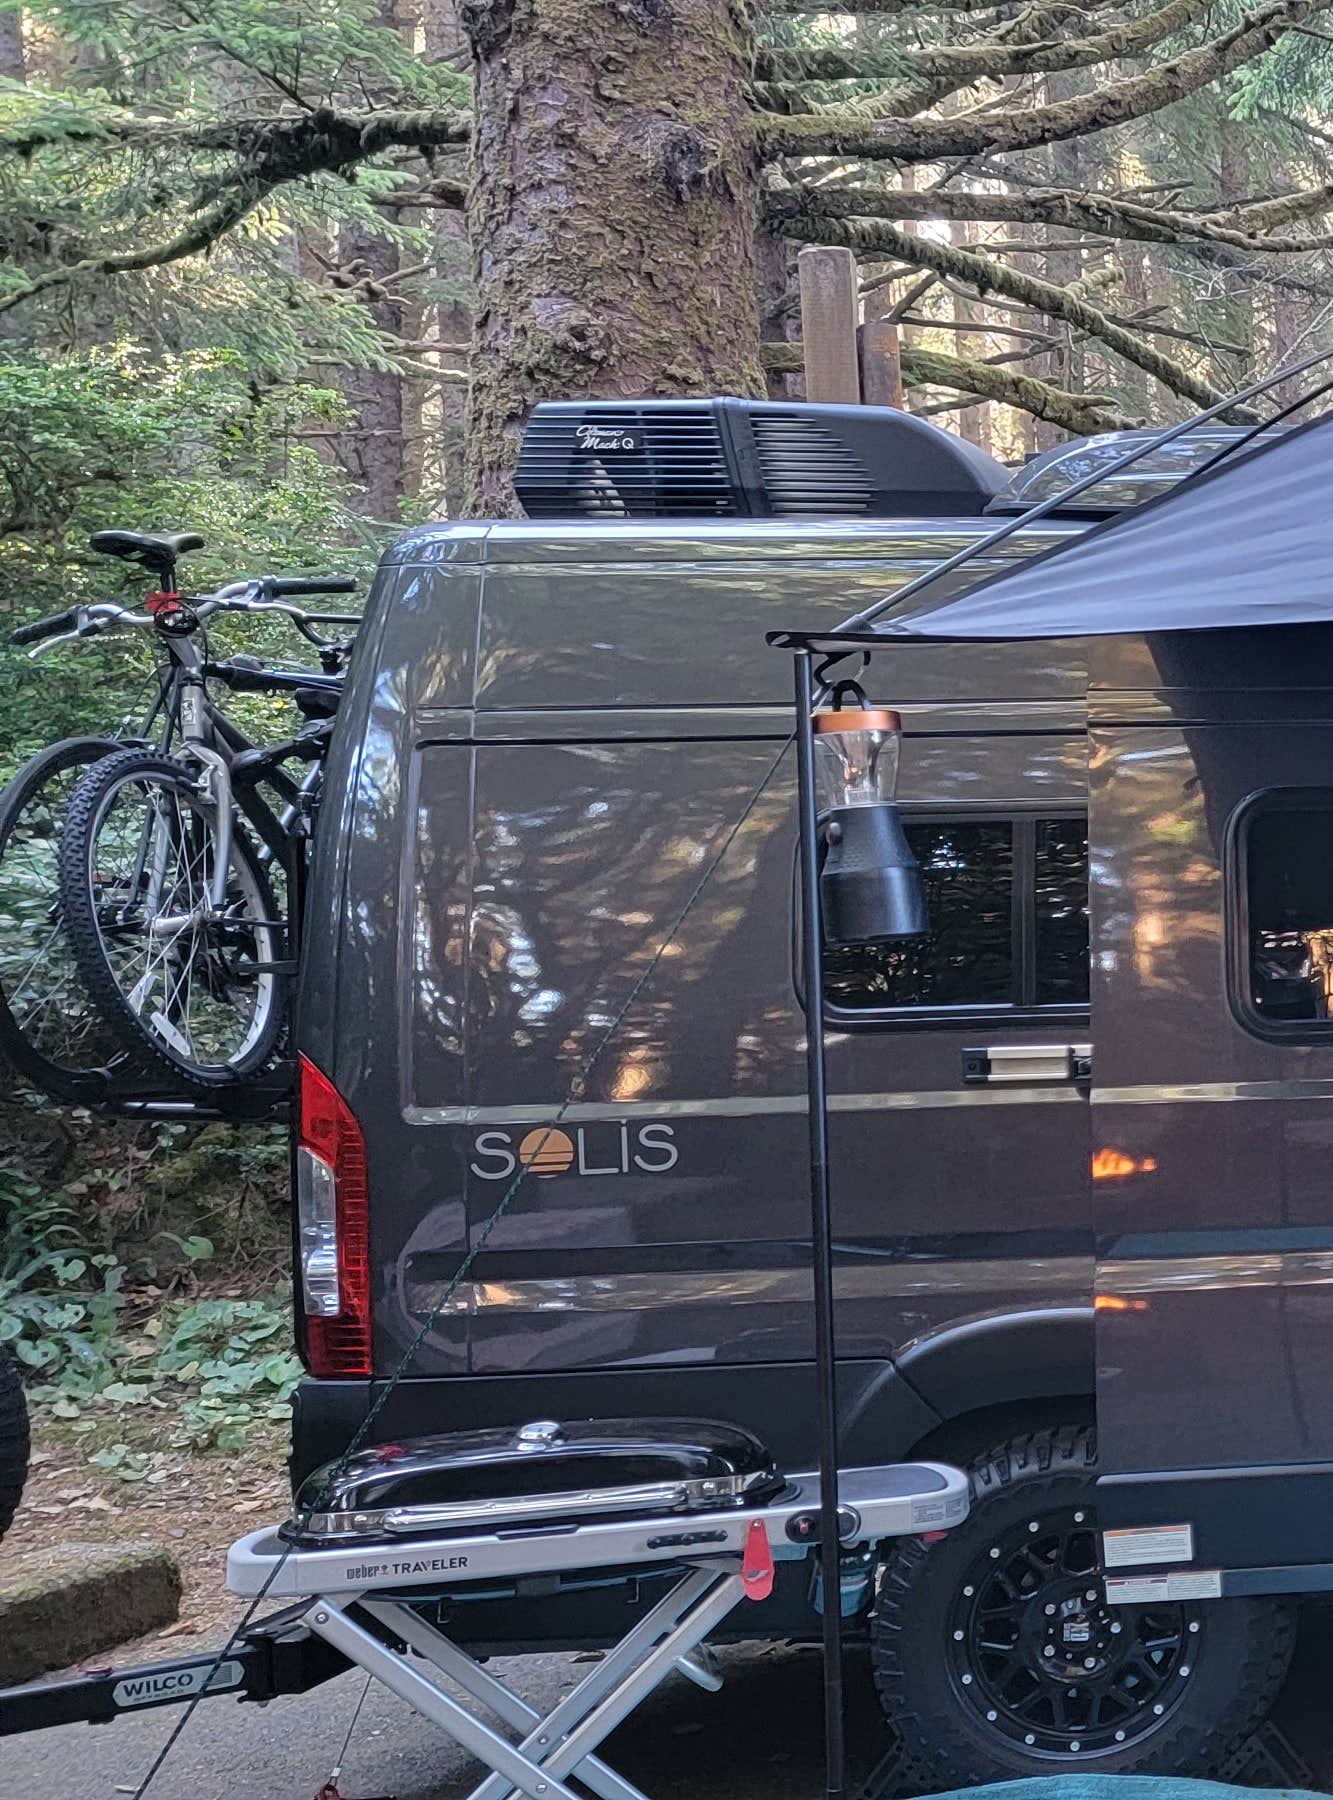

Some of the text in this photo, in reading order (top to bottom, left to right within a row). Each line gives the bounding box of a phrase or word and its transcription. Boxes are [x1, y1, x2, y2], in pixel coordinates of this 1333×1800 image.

[622, 438, 635, 449] Q
[346, 1557, 468, 1580] weber TRAVELER
[123, 1674, 194, 1697] WILCO
